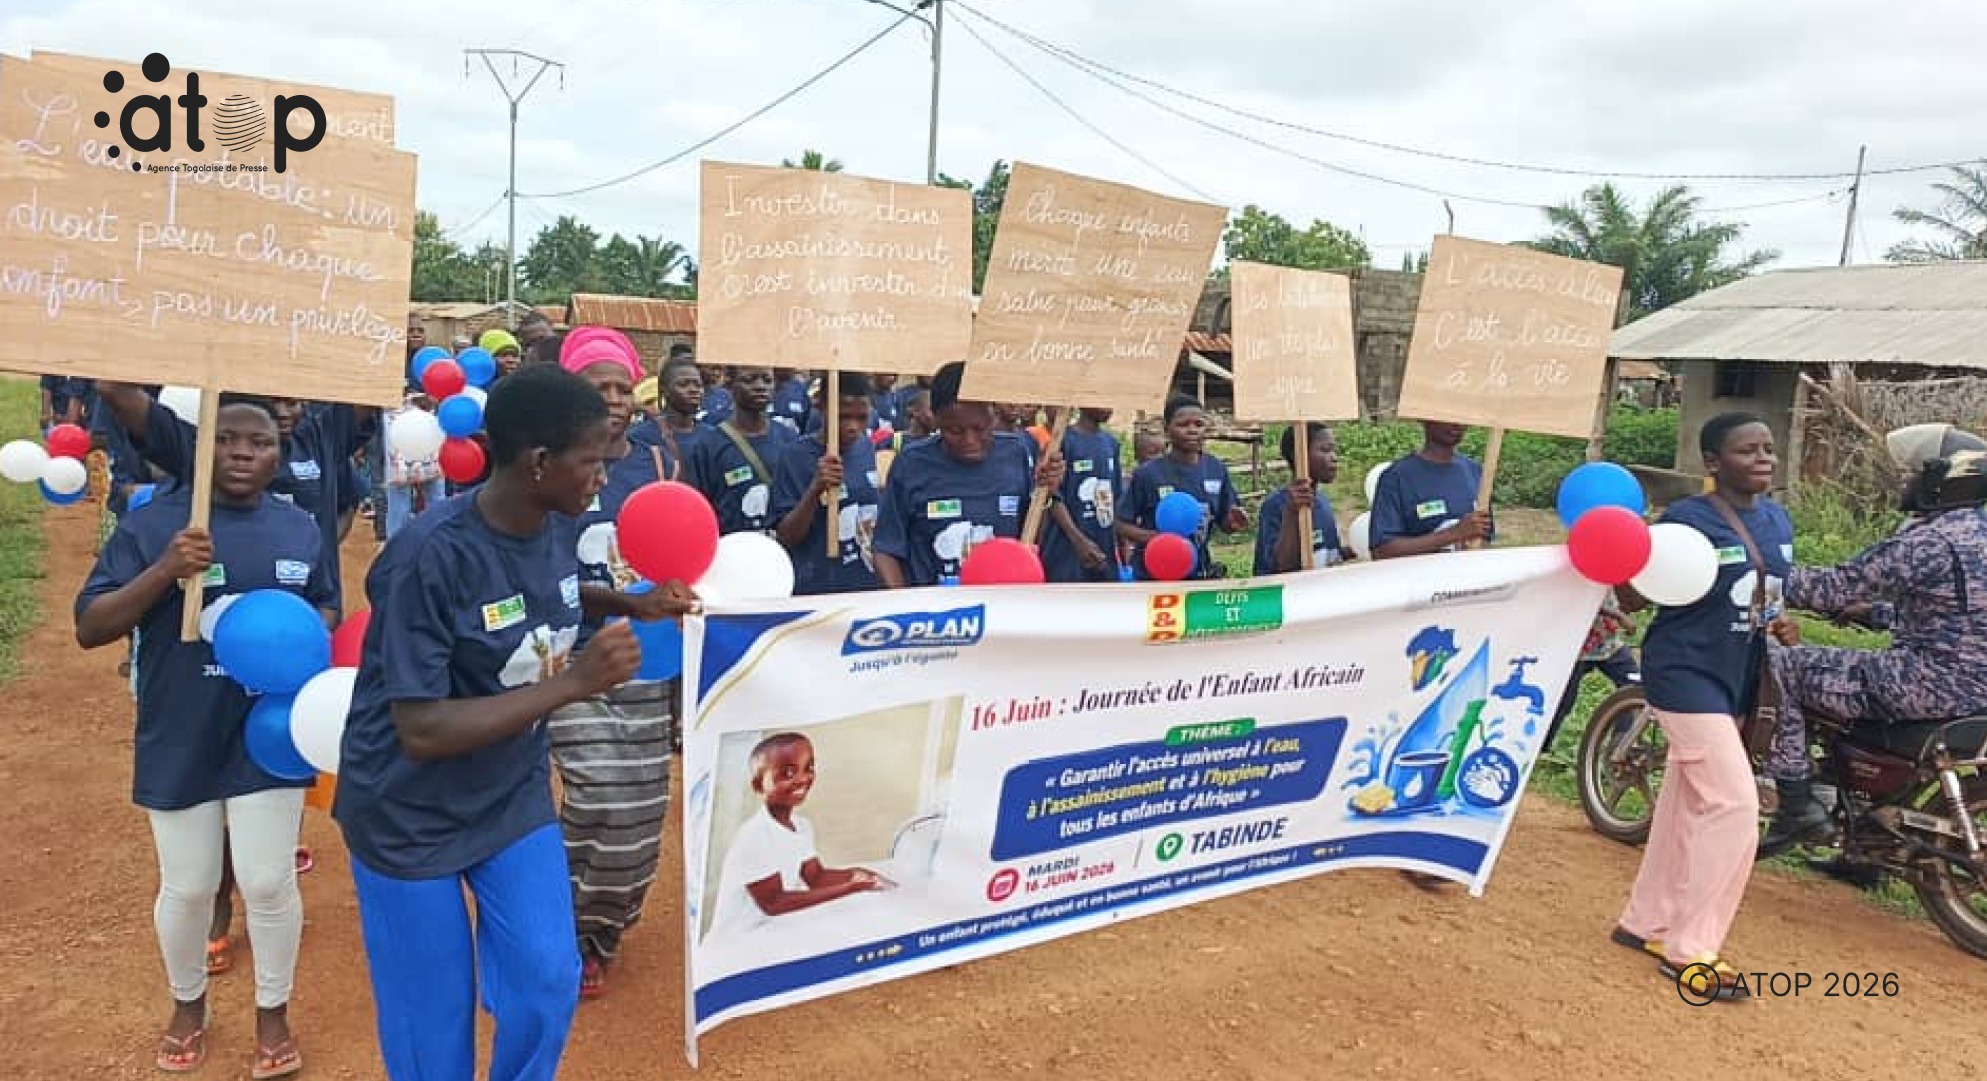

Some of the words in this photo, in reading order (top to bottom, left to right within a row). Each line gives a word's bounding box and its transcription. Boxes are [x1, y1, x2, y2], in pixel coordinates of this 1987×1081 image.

[877, 183, 939, 224] dans
[14, 186, 118, 241] droit
[137, 221, 225, 274] pour
[152, 290, 213, 328] pas
[907, 616, 979, 638] PLAN
[972, 703, 997, 730] 16
[1002, 696, 1053, 724] Juin
[1059, 698, 1067, 714] :
[1073, 681, 1163, 713] Journée
[1166, 679, 1192, 701] de
[1198, 671, 1282, 699] l'Enfant
[1284, 663, 1365, 690] Africain
[1060, 759, 1127, 787] Garantir
[1182, 740, 1251, 766] universel
[1168, 774, 1186, 790] et
[1269, 759, 1306, 779] pour
[1060, 817, 1094, 838] tous
[1096, 810, 1118, 829] les
[1028, 857, 1079, 876] MARDI
[1191, 817, 1288, 855] TABINDE
[1042, 870, 1078, 888] JUIN
